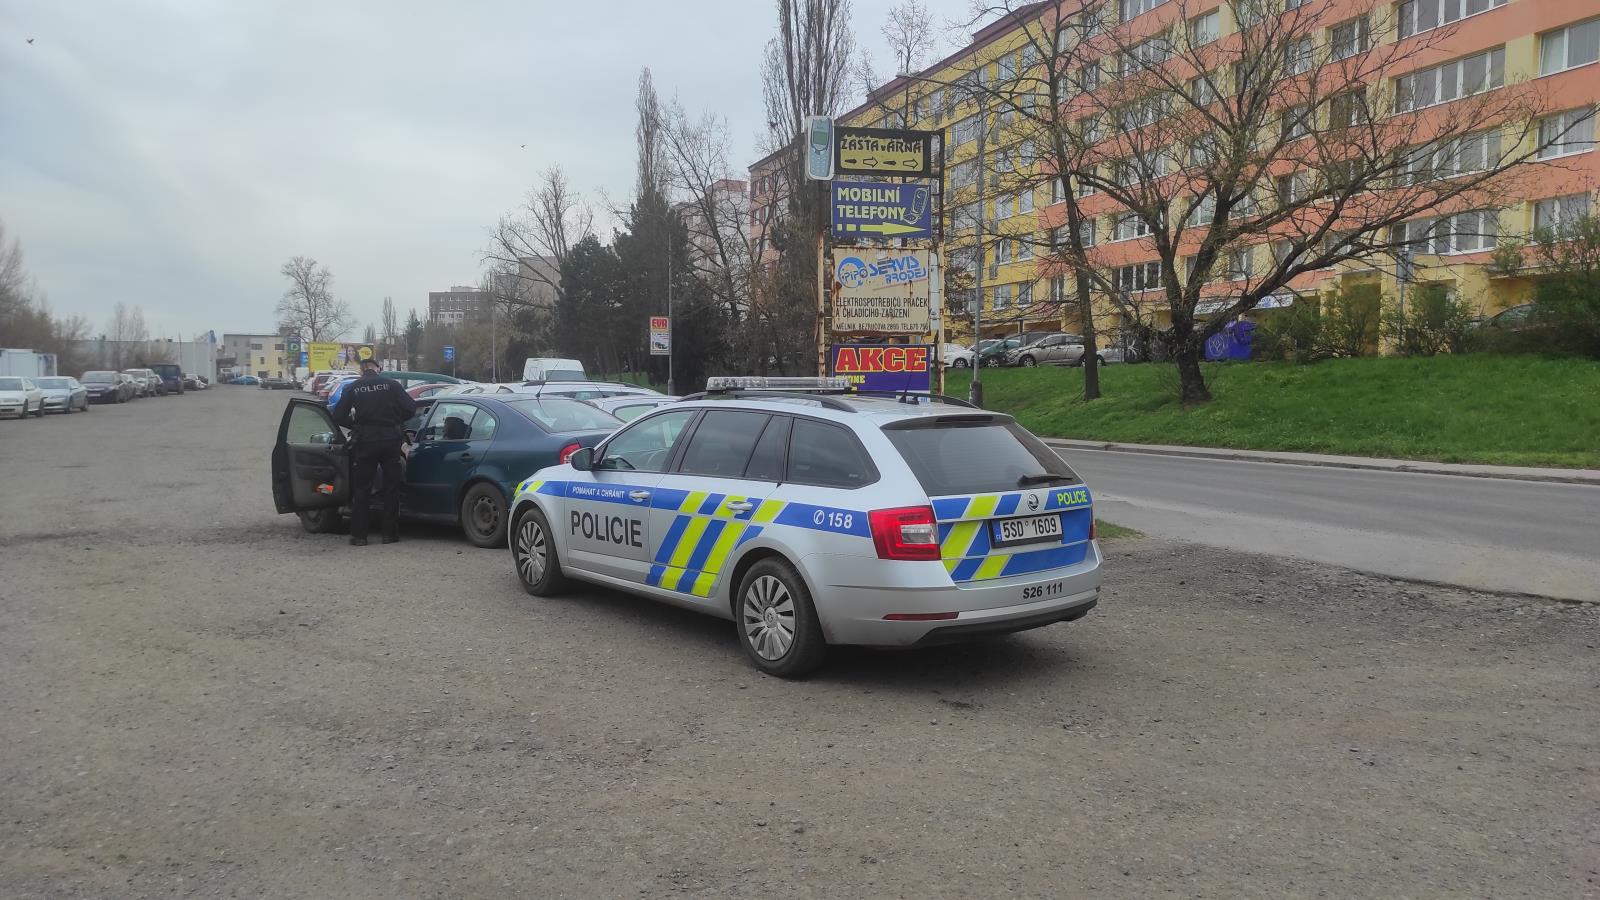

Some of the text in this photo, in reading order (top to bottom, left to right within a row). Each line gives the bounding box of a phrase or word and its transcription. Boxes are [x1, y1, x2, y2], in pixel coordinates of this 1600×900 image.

[837, 187, 900, 203] MOBILNÍ
[837, 205, 906, 219] TELEFONY
[835, 348, 927, 373] AKCE
[1057, 490, 1087, 506] POLICIE
[571, 510, 642, 548] POLICIE
[829, 512, 853, 529] 158
[1002, 517, 1057, 538] 5SD 1609
[1022, 582, 1063, 600] S26 111
